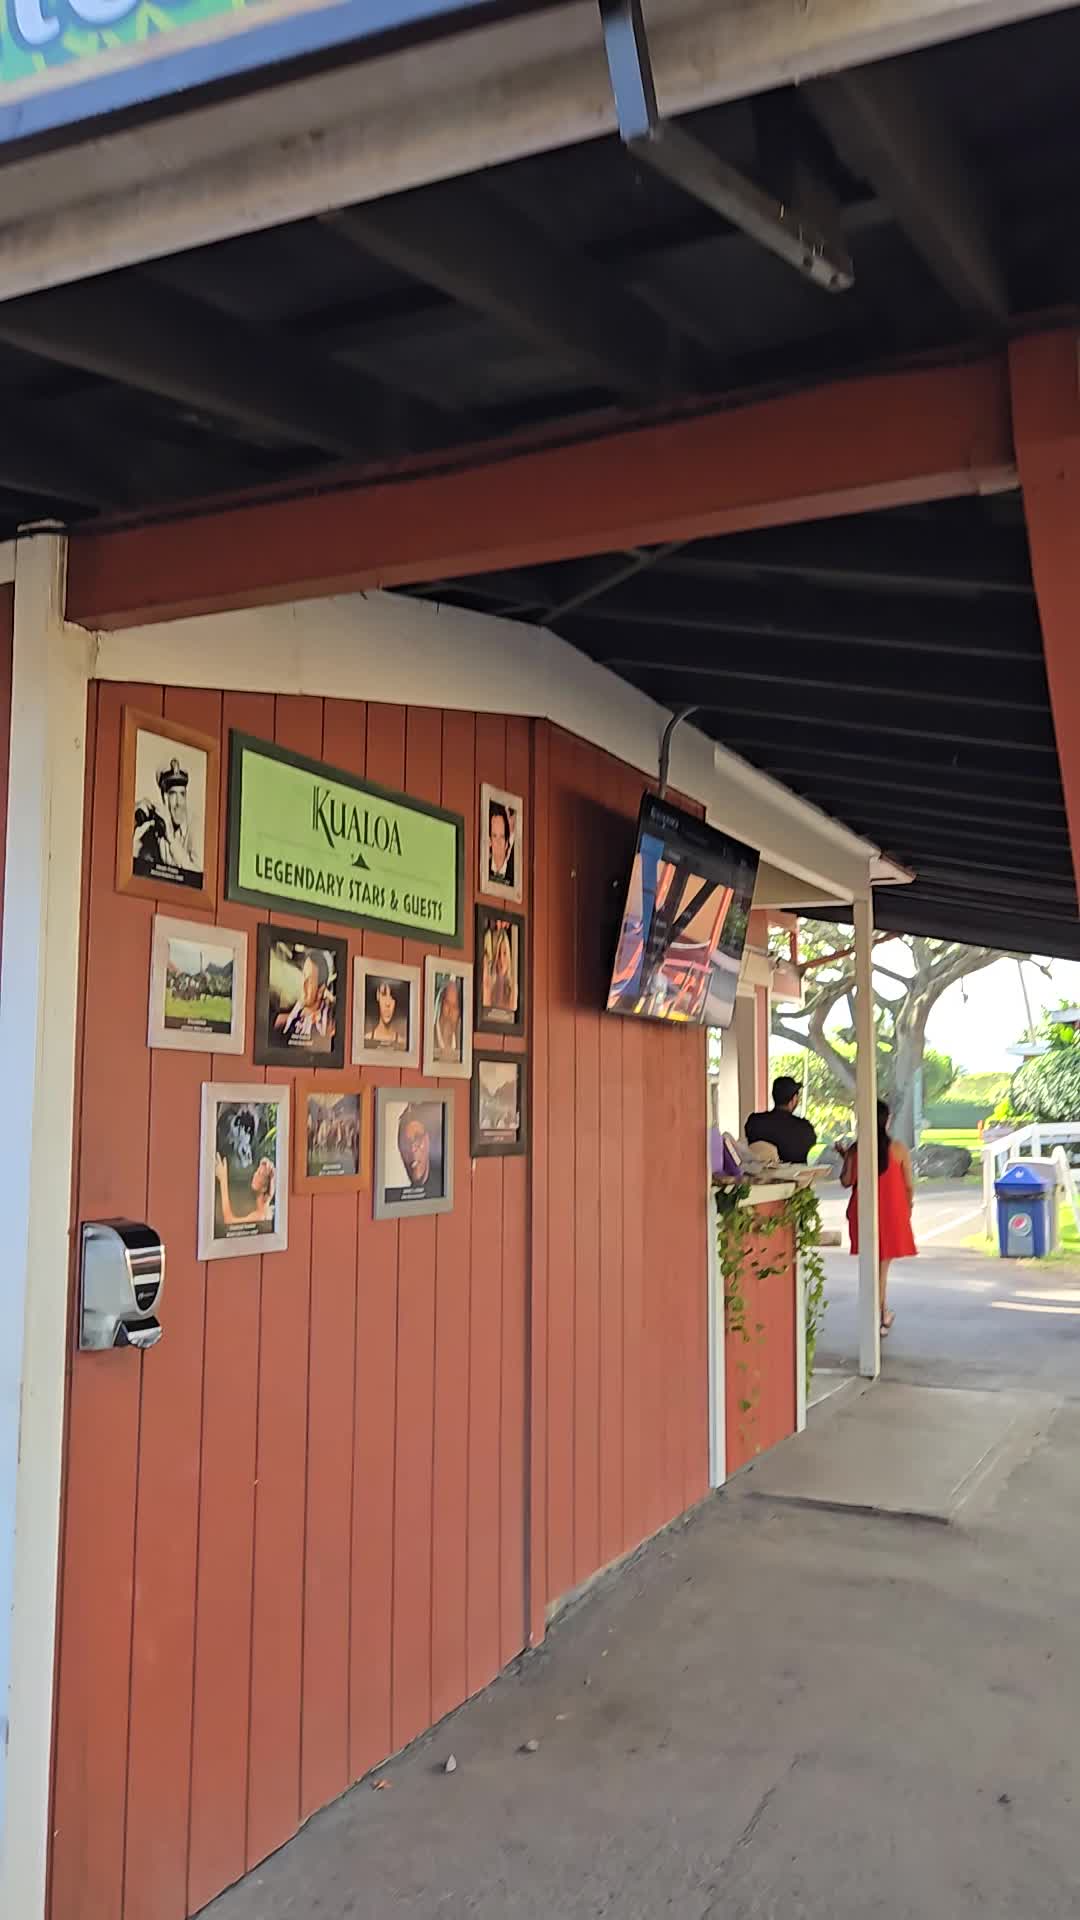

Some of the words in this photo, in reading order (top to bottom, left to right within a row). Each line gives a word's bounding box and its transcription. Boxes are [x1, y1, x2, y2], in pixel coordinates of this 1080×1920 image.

[312, 785, 402, 856] KUALOA
[255, 853, 344, 897] LEGENDARY
[349, 879, 385, 908] STARS
[390, 889, 399, 911] &
[403, 893, 443, 921] GUESTS
